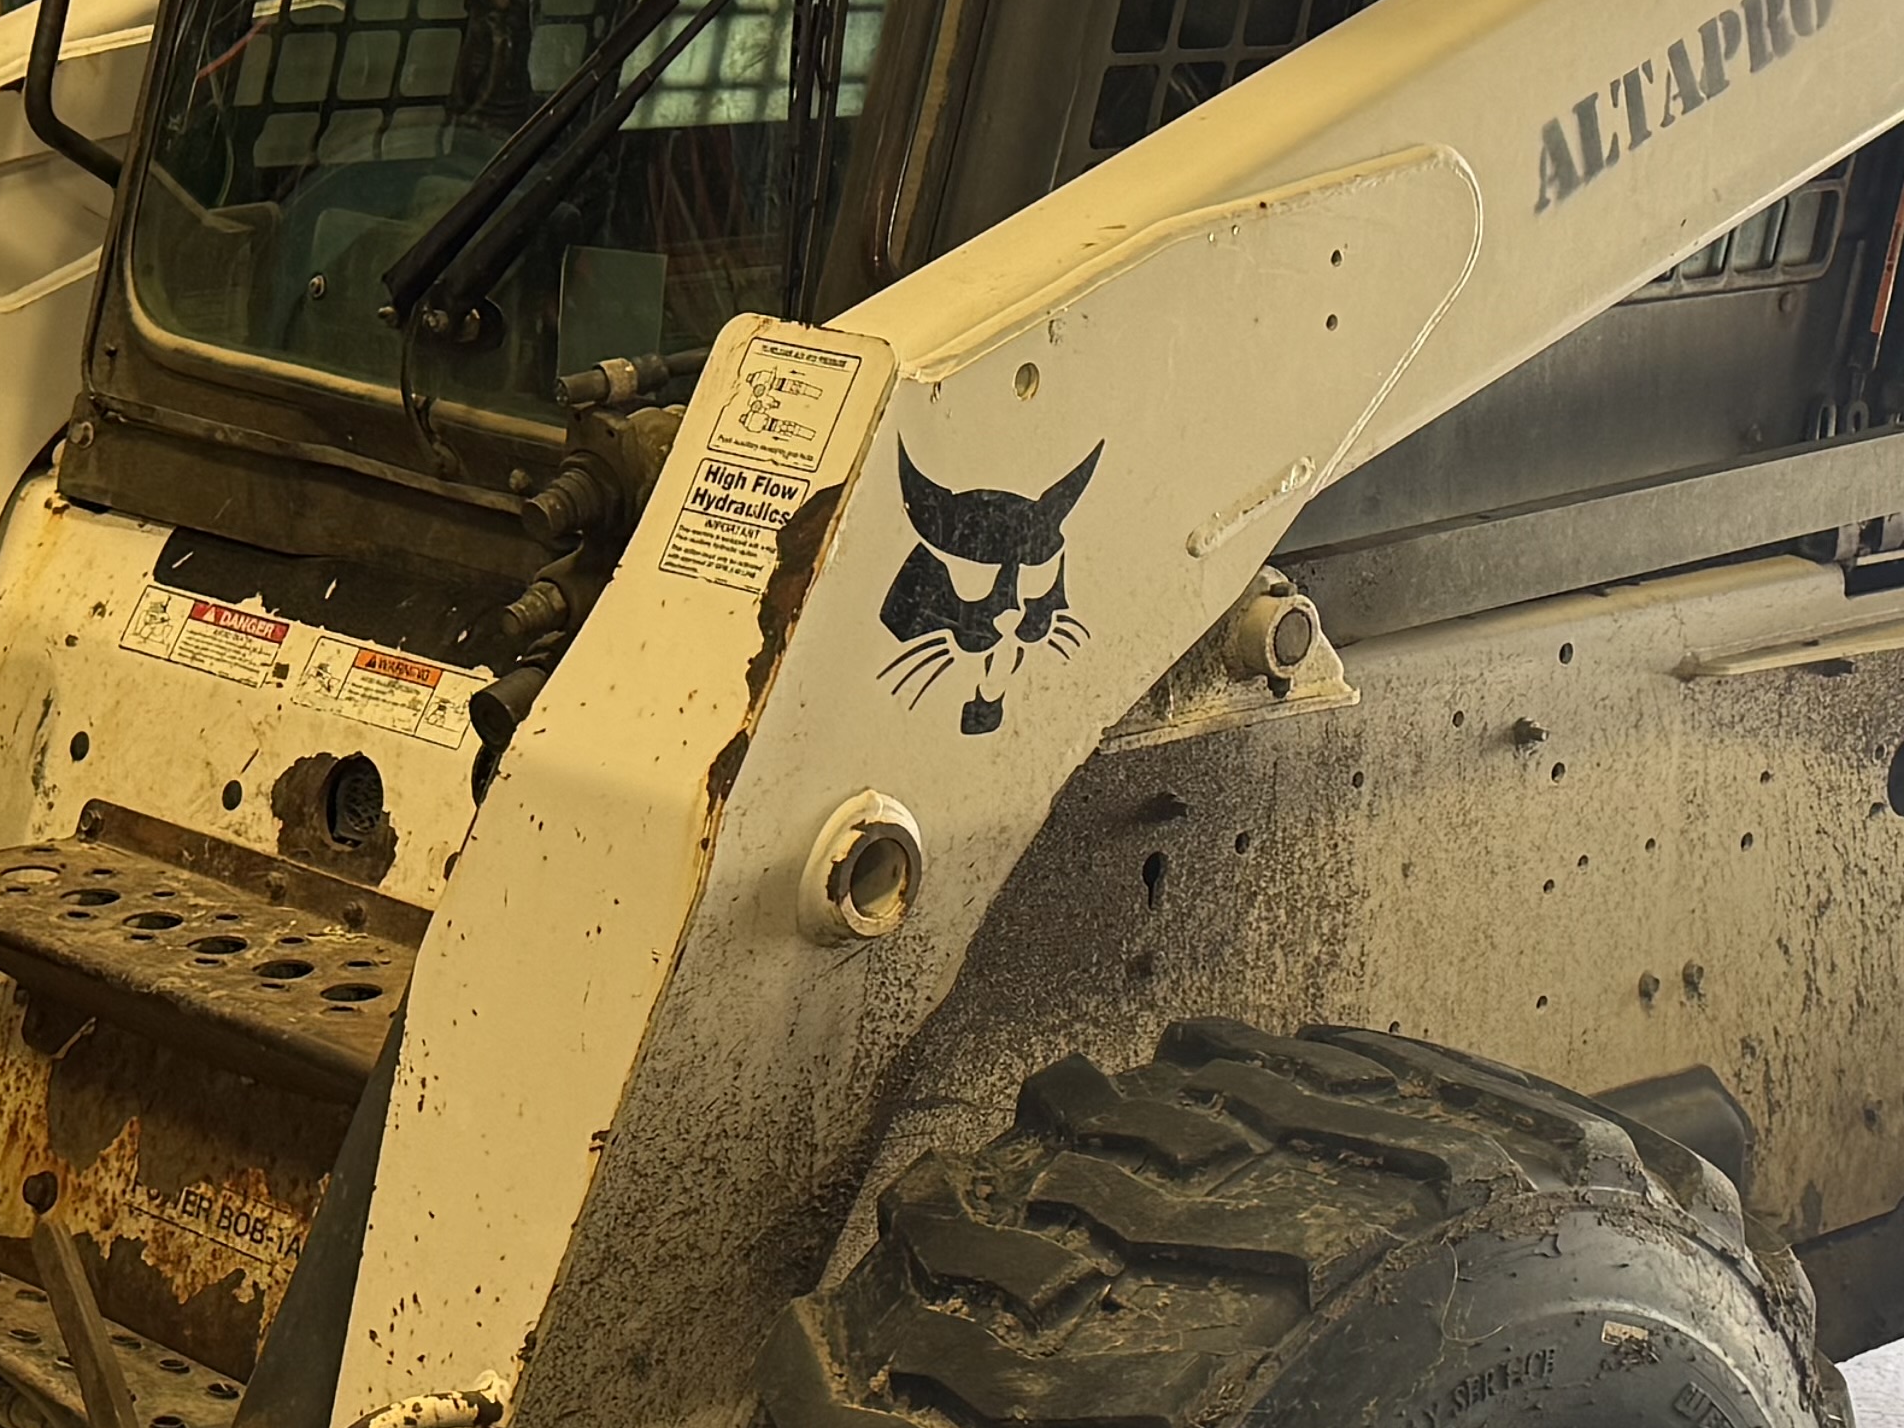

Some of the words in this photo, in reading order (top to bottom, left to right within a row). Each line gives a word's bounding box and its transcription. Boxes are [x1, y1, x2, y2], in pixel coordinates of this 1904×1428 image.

[704, 463, 747, 493] High
[753, 475, 799, 501] Flow
[690, 487, 794, 526] Hydraulics
[220, 609, 275, 639] DANGER
